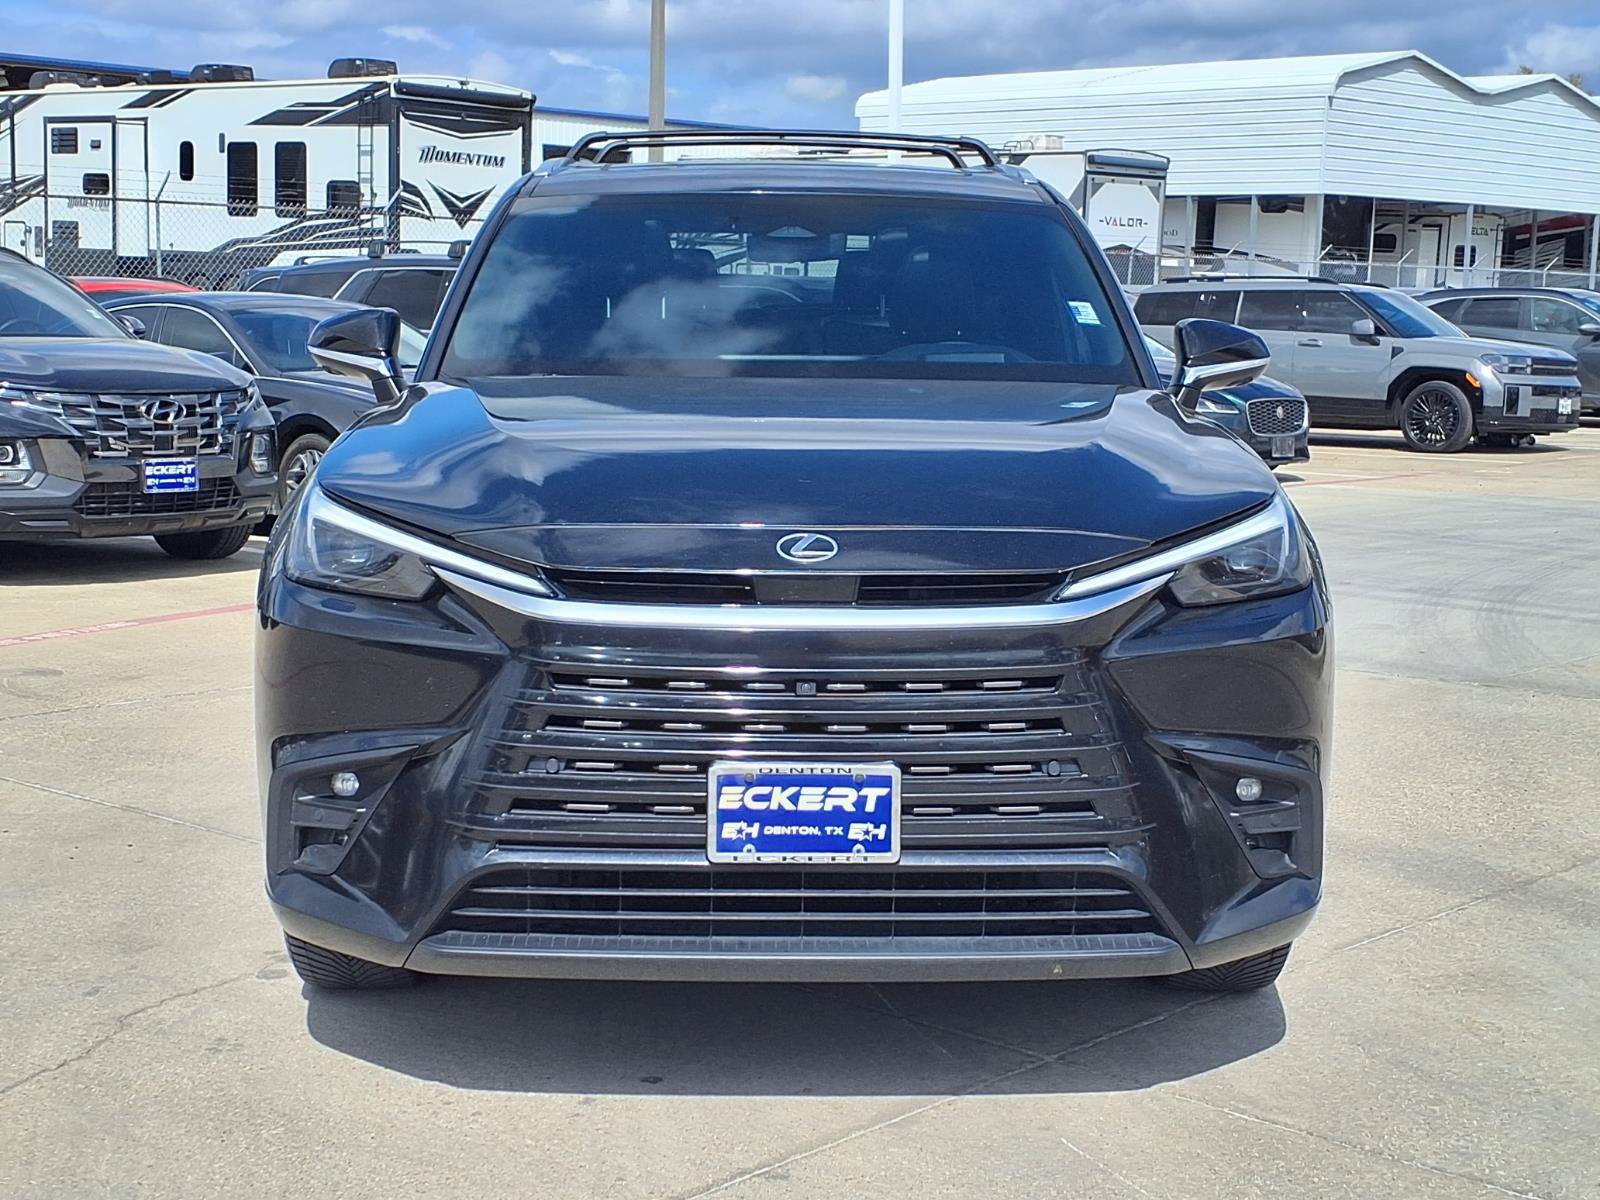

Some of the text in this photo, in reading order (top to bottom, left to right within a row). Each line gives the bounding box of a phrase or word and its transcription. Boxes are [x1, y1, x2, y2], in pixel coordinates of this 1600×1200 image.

[419, 145, 506, 168] MOMENTUM
[1471, 227, 1488, 236] ELTA
[145, 464, 196, 476] ECKERT
[718, 786, 890, 812] ECKERT
[764, 825, 821, 836] DENTON,
[825, 826, 844, 836] TX
